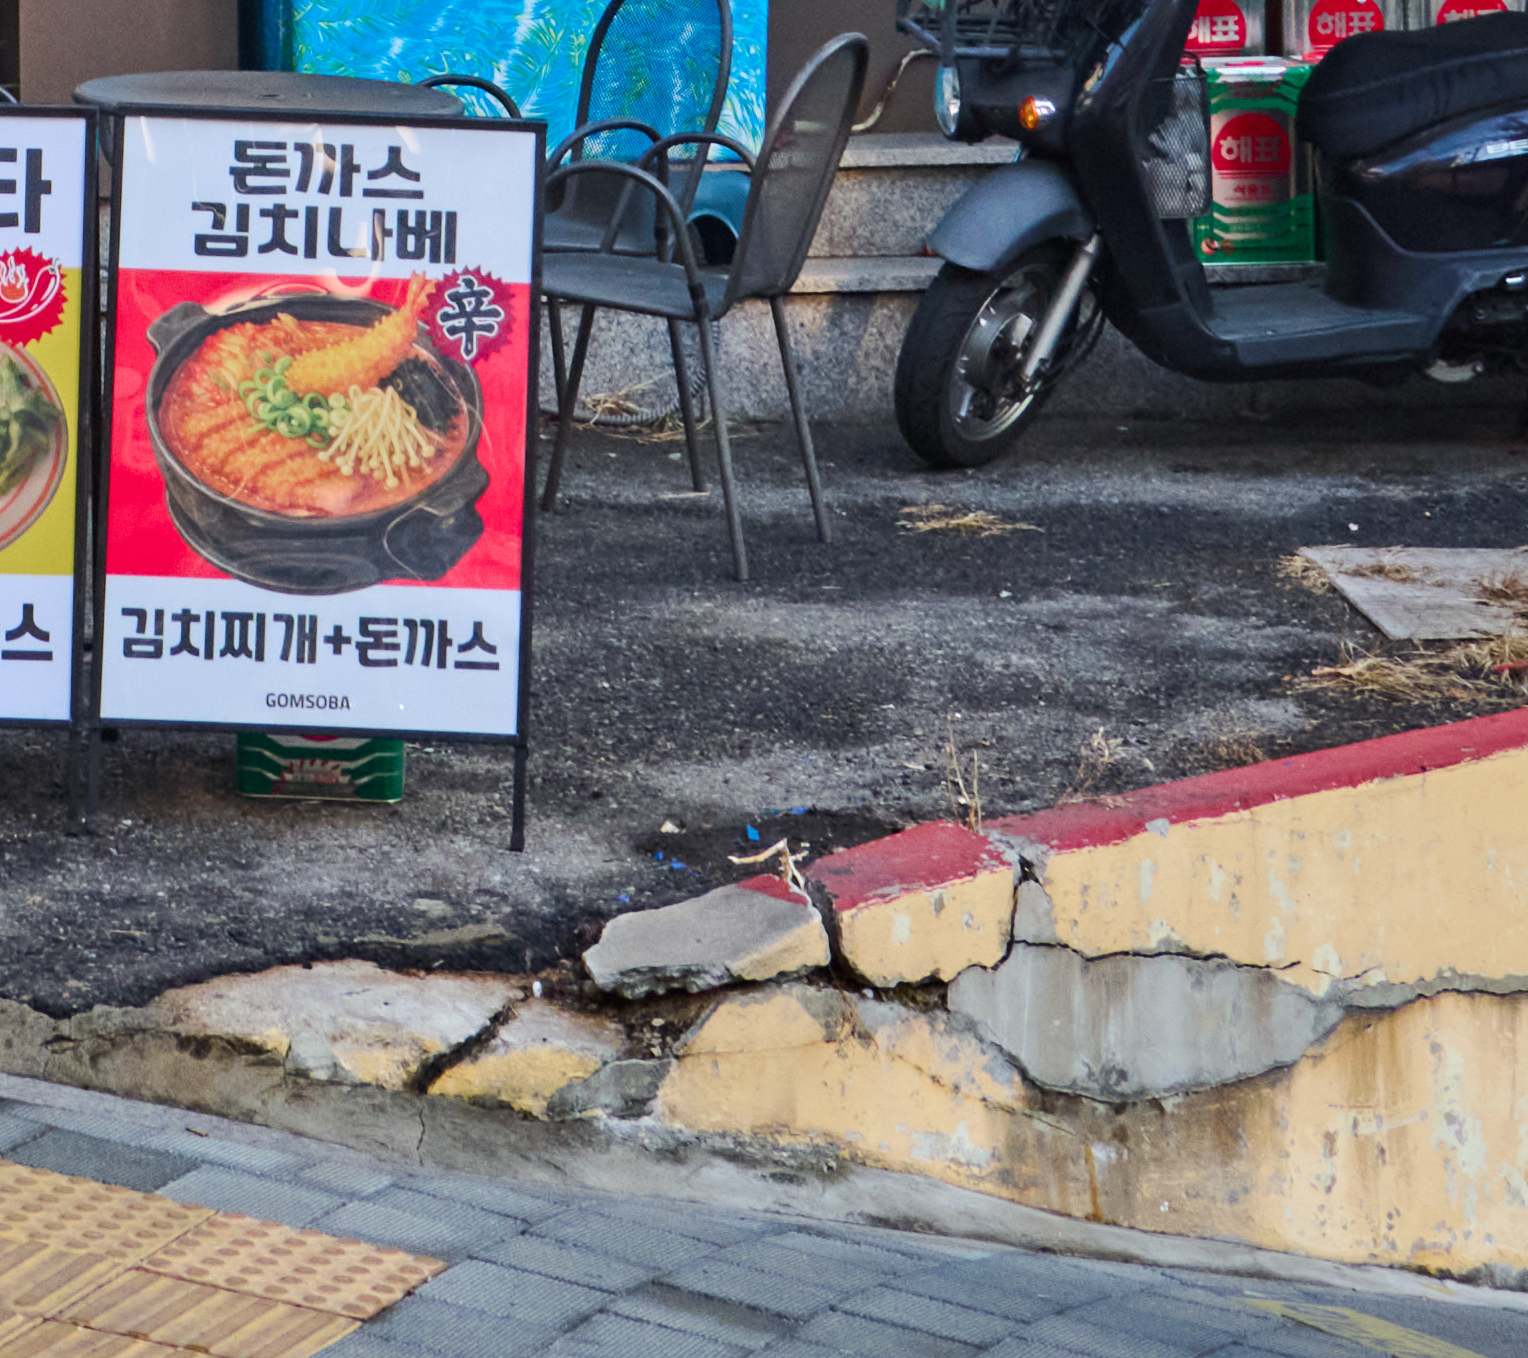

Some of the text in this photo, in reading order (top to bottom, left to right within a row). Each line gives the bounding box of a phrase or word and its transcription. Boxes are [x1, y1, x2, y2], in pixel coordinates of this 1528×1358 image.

[1316, 11, 1376, 38] 해표
[227, 140, 425, 199] 돈까스
[1220, 135, 1282, 164] 해표
[188, 197, 458, 266] 김치나베
[436, 274, 506, 362] 辛
[120, 602, 501, 673] 김치찌개+돈까스
[264, 691, 352, 712] GOMSOBA
